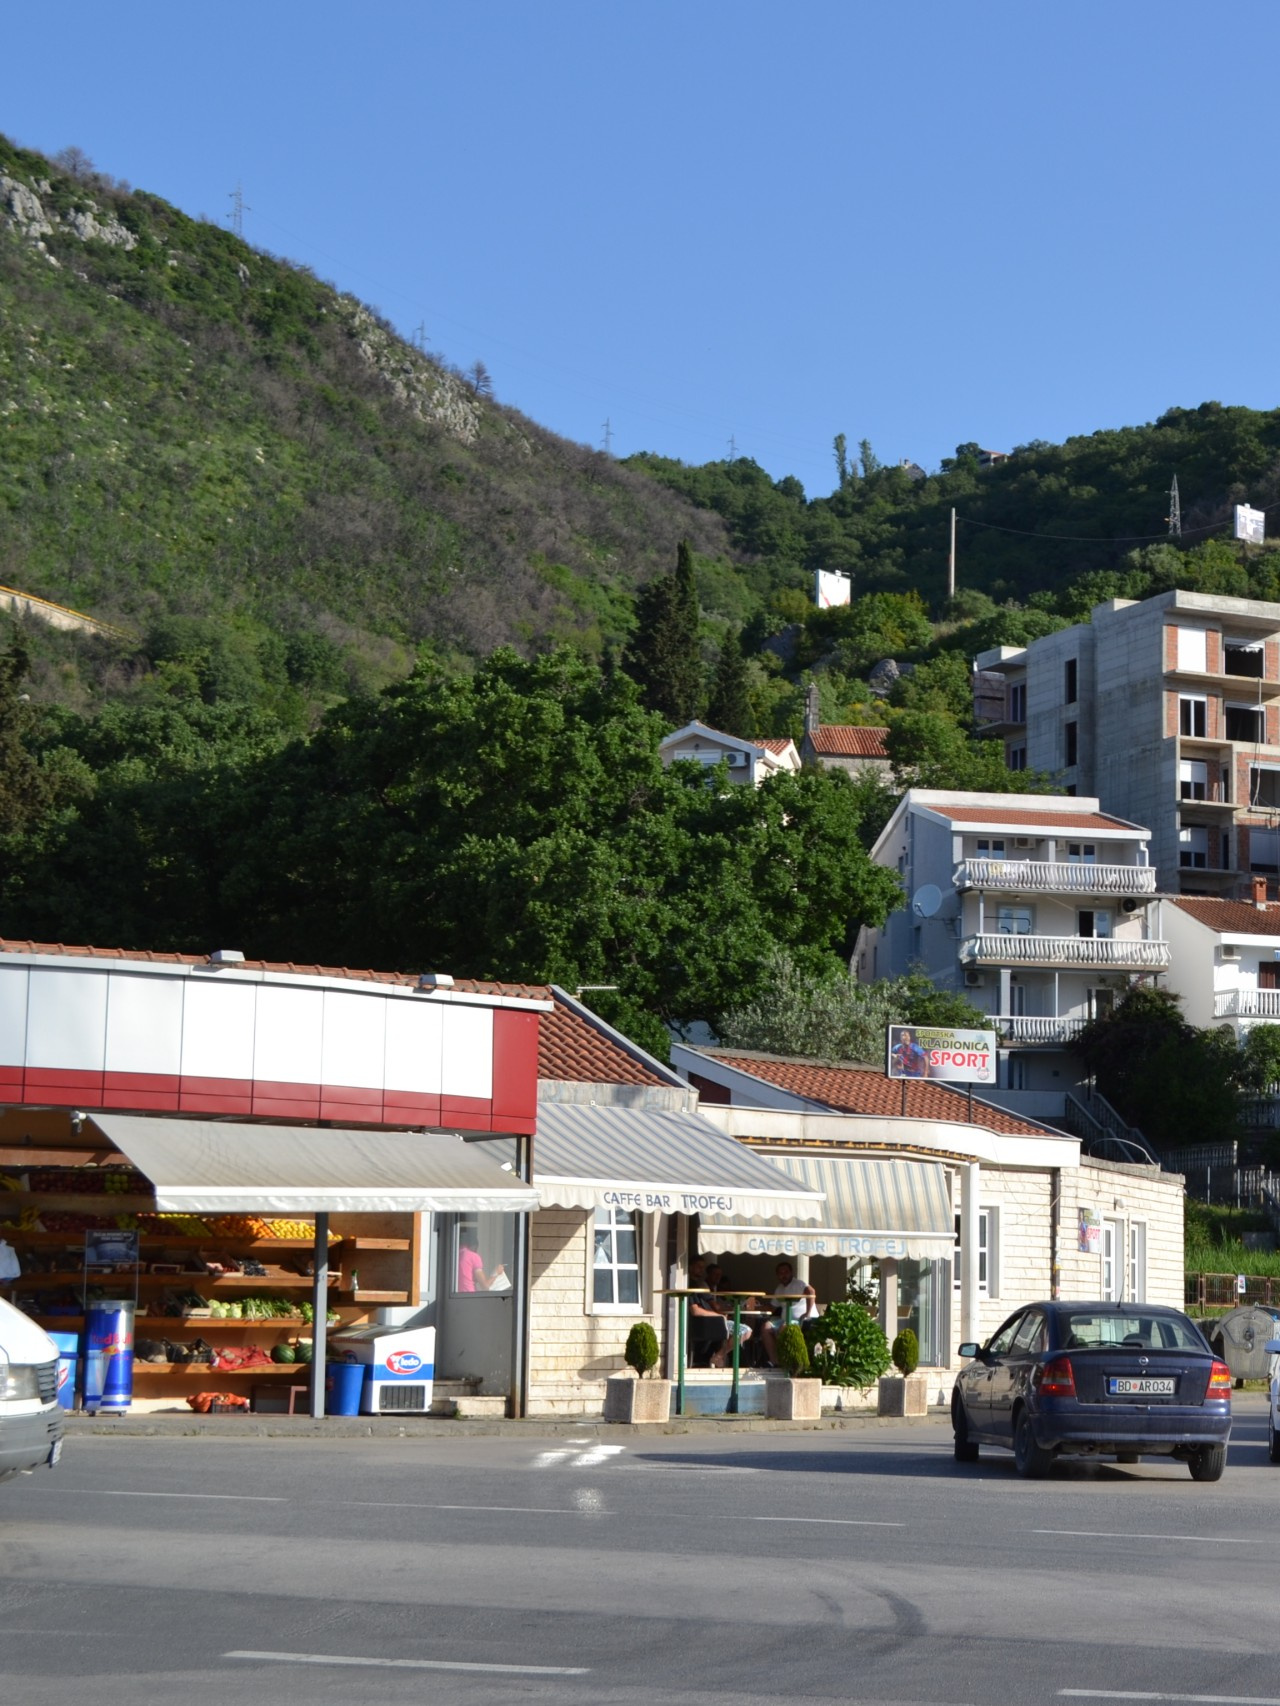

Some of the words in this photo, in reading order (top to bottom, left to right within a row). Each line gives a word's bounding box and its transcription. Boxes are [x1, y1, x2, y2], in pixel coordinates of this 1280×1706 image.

[919, 1038, 990, 1051] KLADIONICA
[930, 1050, 990, 1068] SPORT
[603, 1191, 641, 1206] CAFFE
[646, 1194, 671, 1208] BAR
[681, 1194, 733, 1211] TROFEJ
[748, 1237, 793, 1251] CAFFE
[799, 1239, 826, 1253] BAR
[838, 1236, 908, 1255] TROFEJ
[1118, 1381, 1132, 1392] BD
